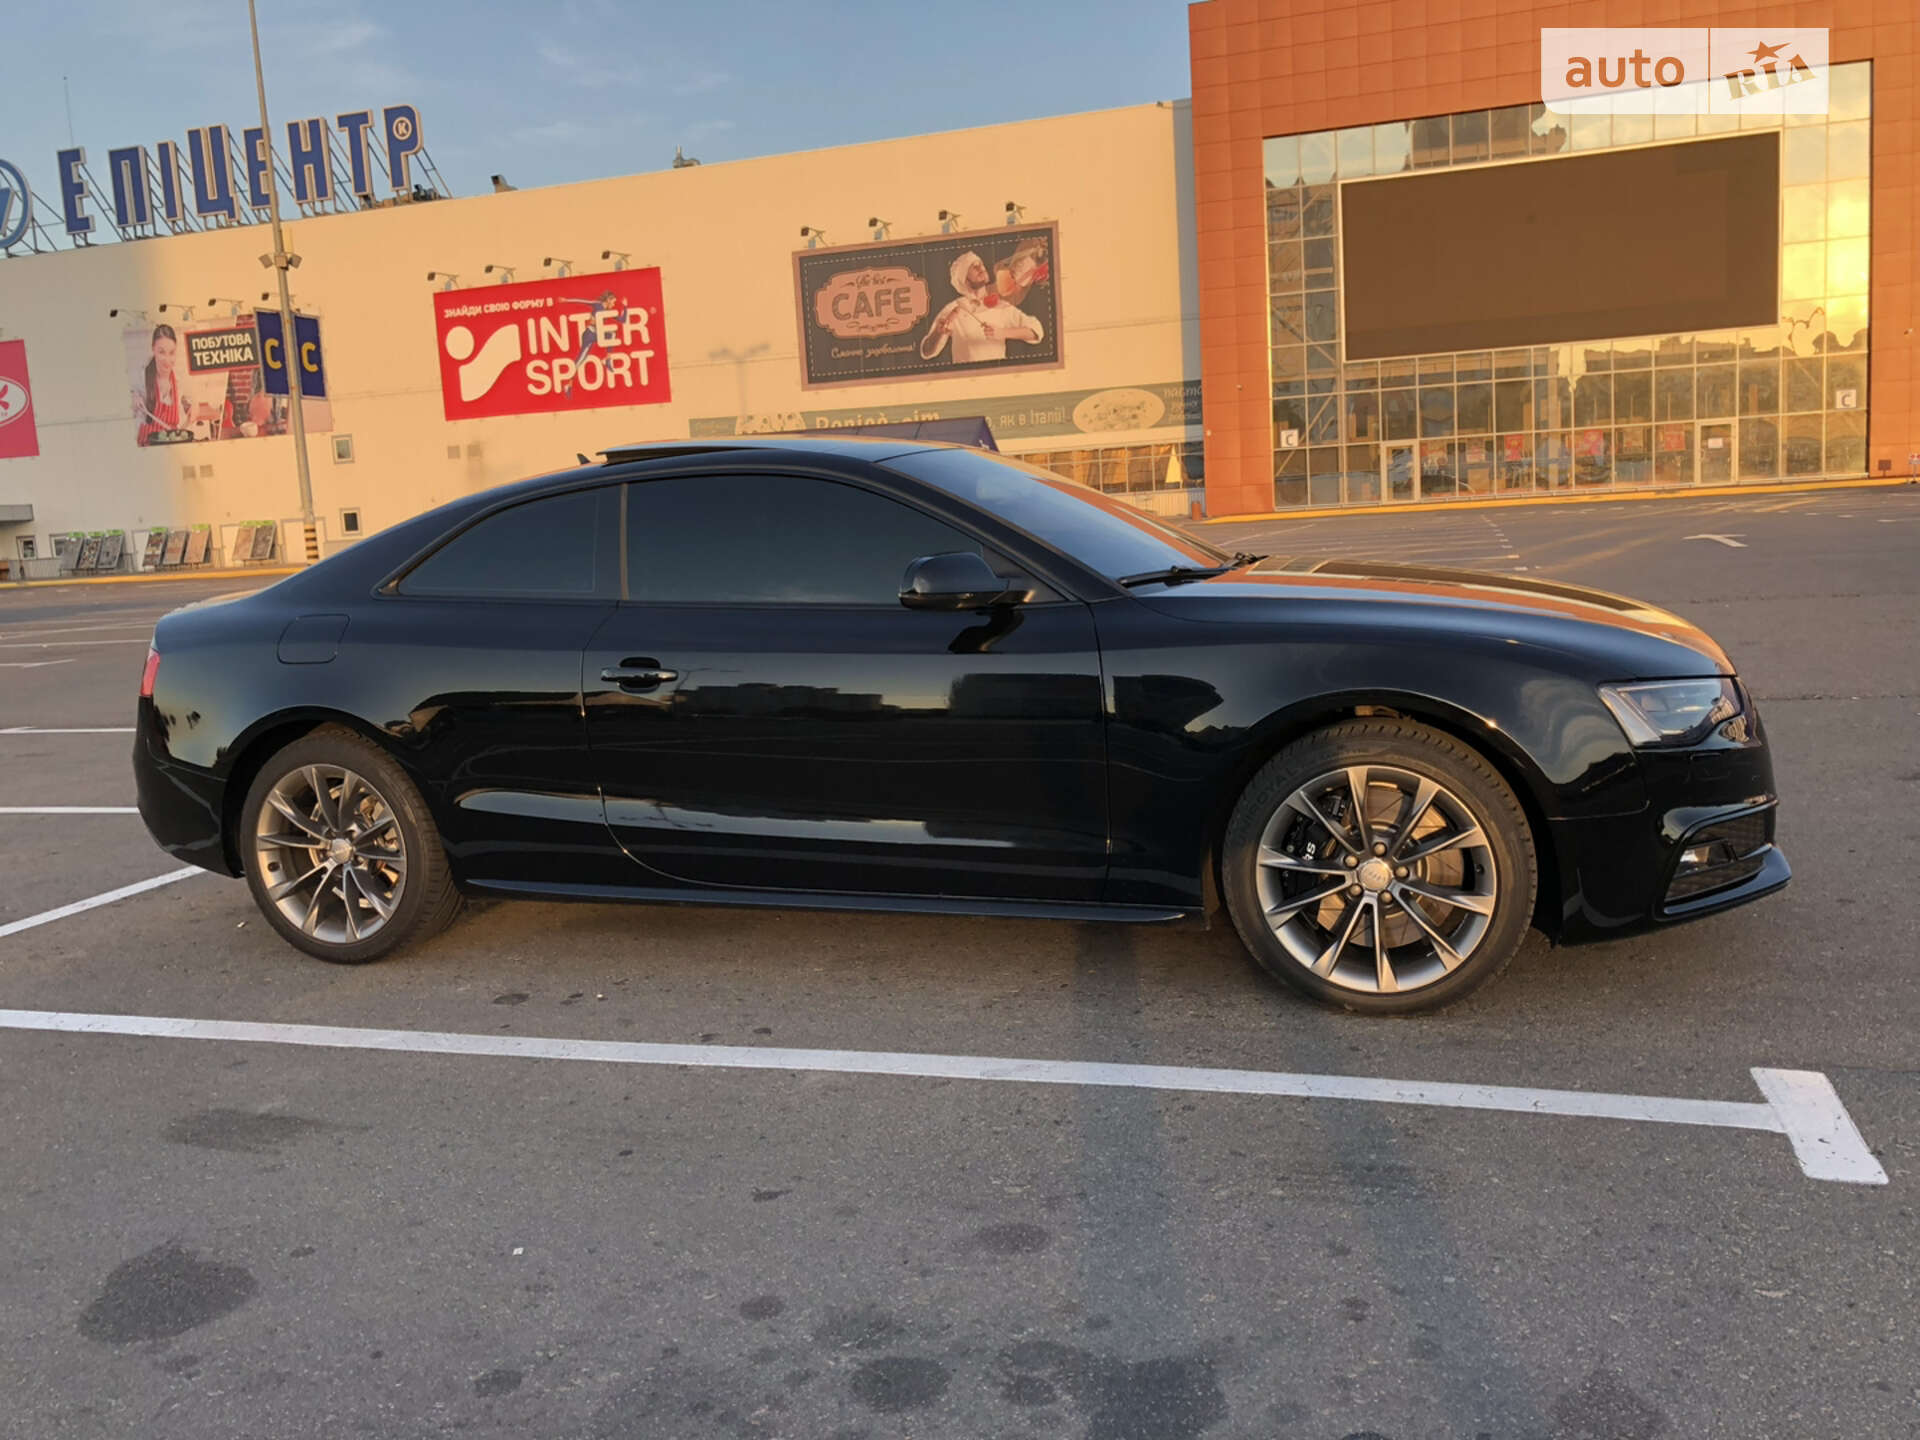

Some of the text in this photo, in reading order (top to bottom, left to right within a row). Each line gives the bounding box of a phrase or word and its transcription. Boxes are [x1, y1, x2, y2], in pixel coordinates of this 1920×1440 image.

[57, 104, 423, 235] ЕПІЦЕНТР
[444, 297, 553, 318] ЗНАЙДИ СВОЮ ФОРМУ В
[832, 287, 912, 320] CAFE
[192, 333, 252, 350] ПОБУТОВА
[527, 307, 651, 355] INTER
[193, 347, 254, 366] ТЕХНІКА
[264, 338, 282, 369] C
[301, 342, 319, 372] C
[526, 350, 655, 395] SPORT
